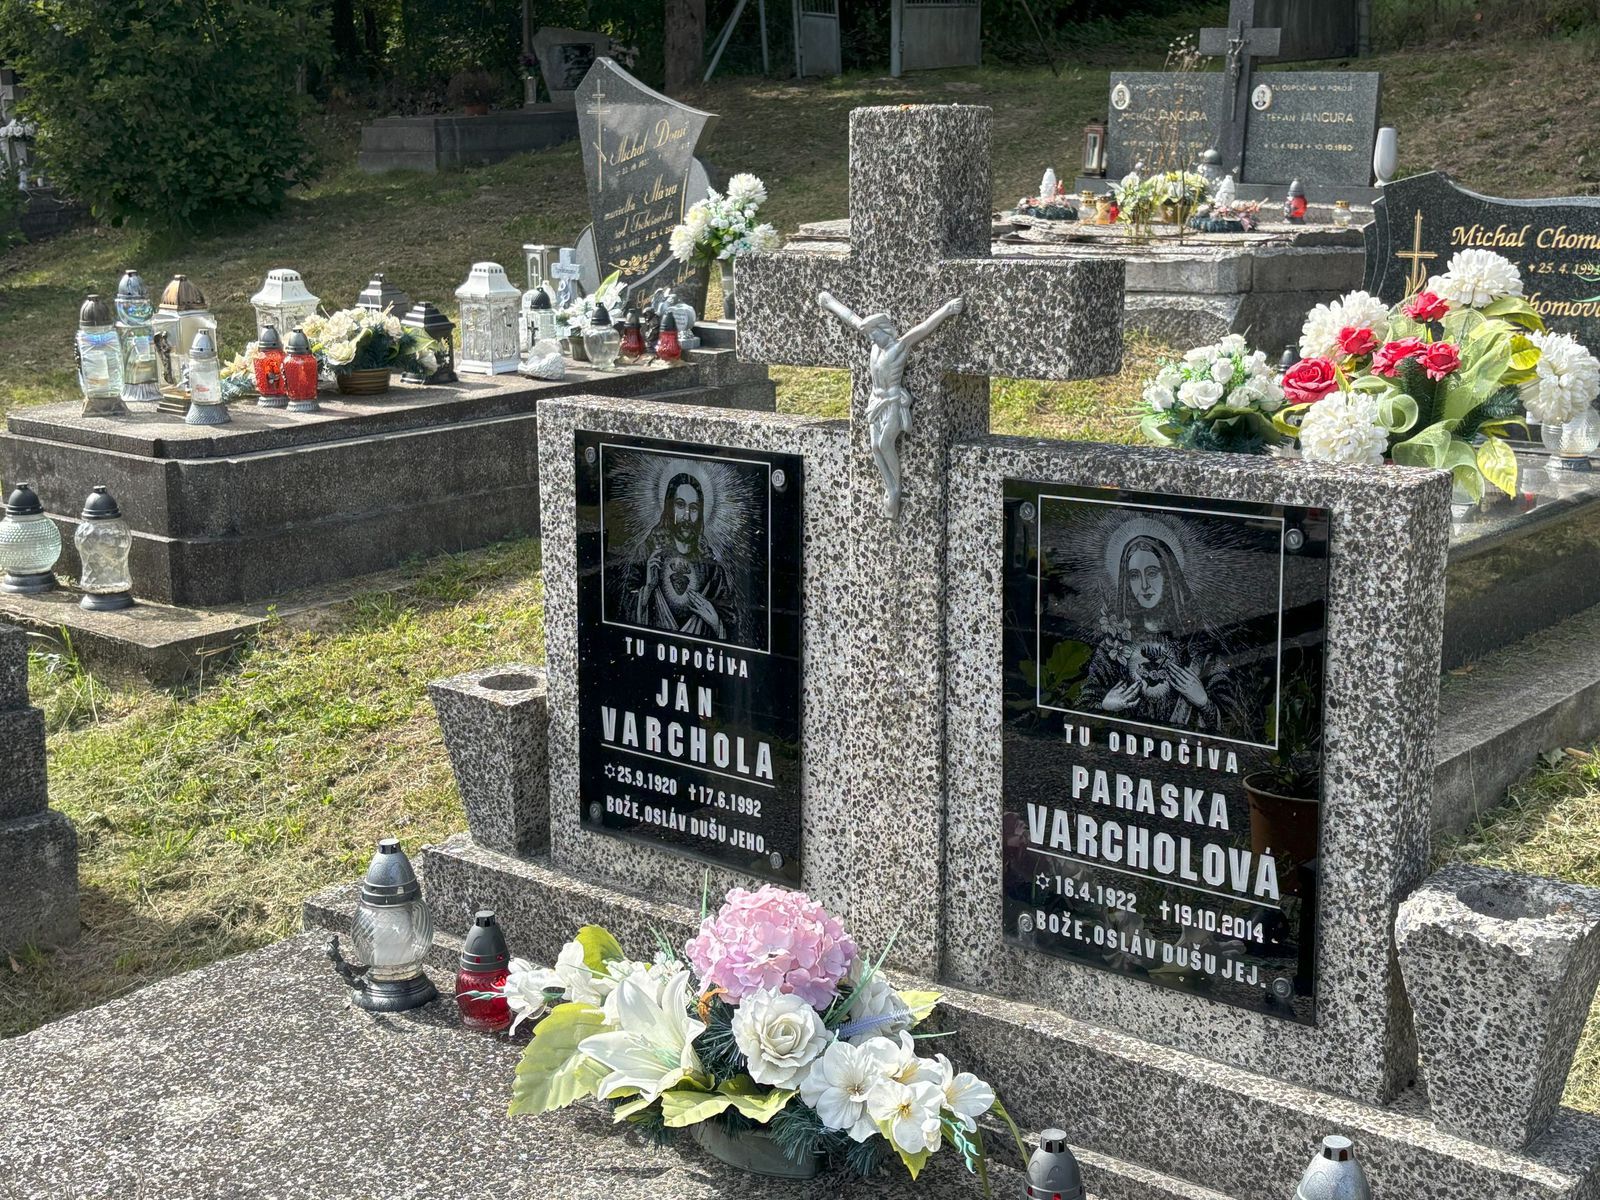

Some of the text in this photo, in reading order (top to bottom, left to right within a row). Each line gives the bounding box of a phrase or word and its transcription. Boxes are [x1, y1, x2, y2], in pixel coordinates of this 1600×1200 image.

[1156, 110, 1208, 121] ANCURA
[1300, 112, 1355, 123] JANCURA
[1450, 224, 1531, 248] Michal
[1537, 262, 1555, 273] 25.
[1558, 263, 1569, 274] 4.
[1521, 292, 1600, 318] homov
[625, 636, 749, 679] TU ODPOČÍVA
[656, 675, 712, 718] JÁN
[601, 705, 774, 780] VARCHOLA
[1063, 723, 1238, 774] TU ODPOČÍVA
[1072, 765, 1230, 830] PARASKA
[690, 817, 727, 843] DUŠU
[729, 828, 770, 855] JEHO.
[1027, 802, 1280, 900] VARCHOLOVÁ
[1162, 942, 1217, 975] DUŠU
[1221, 958, 1267, 989] JEJ.
